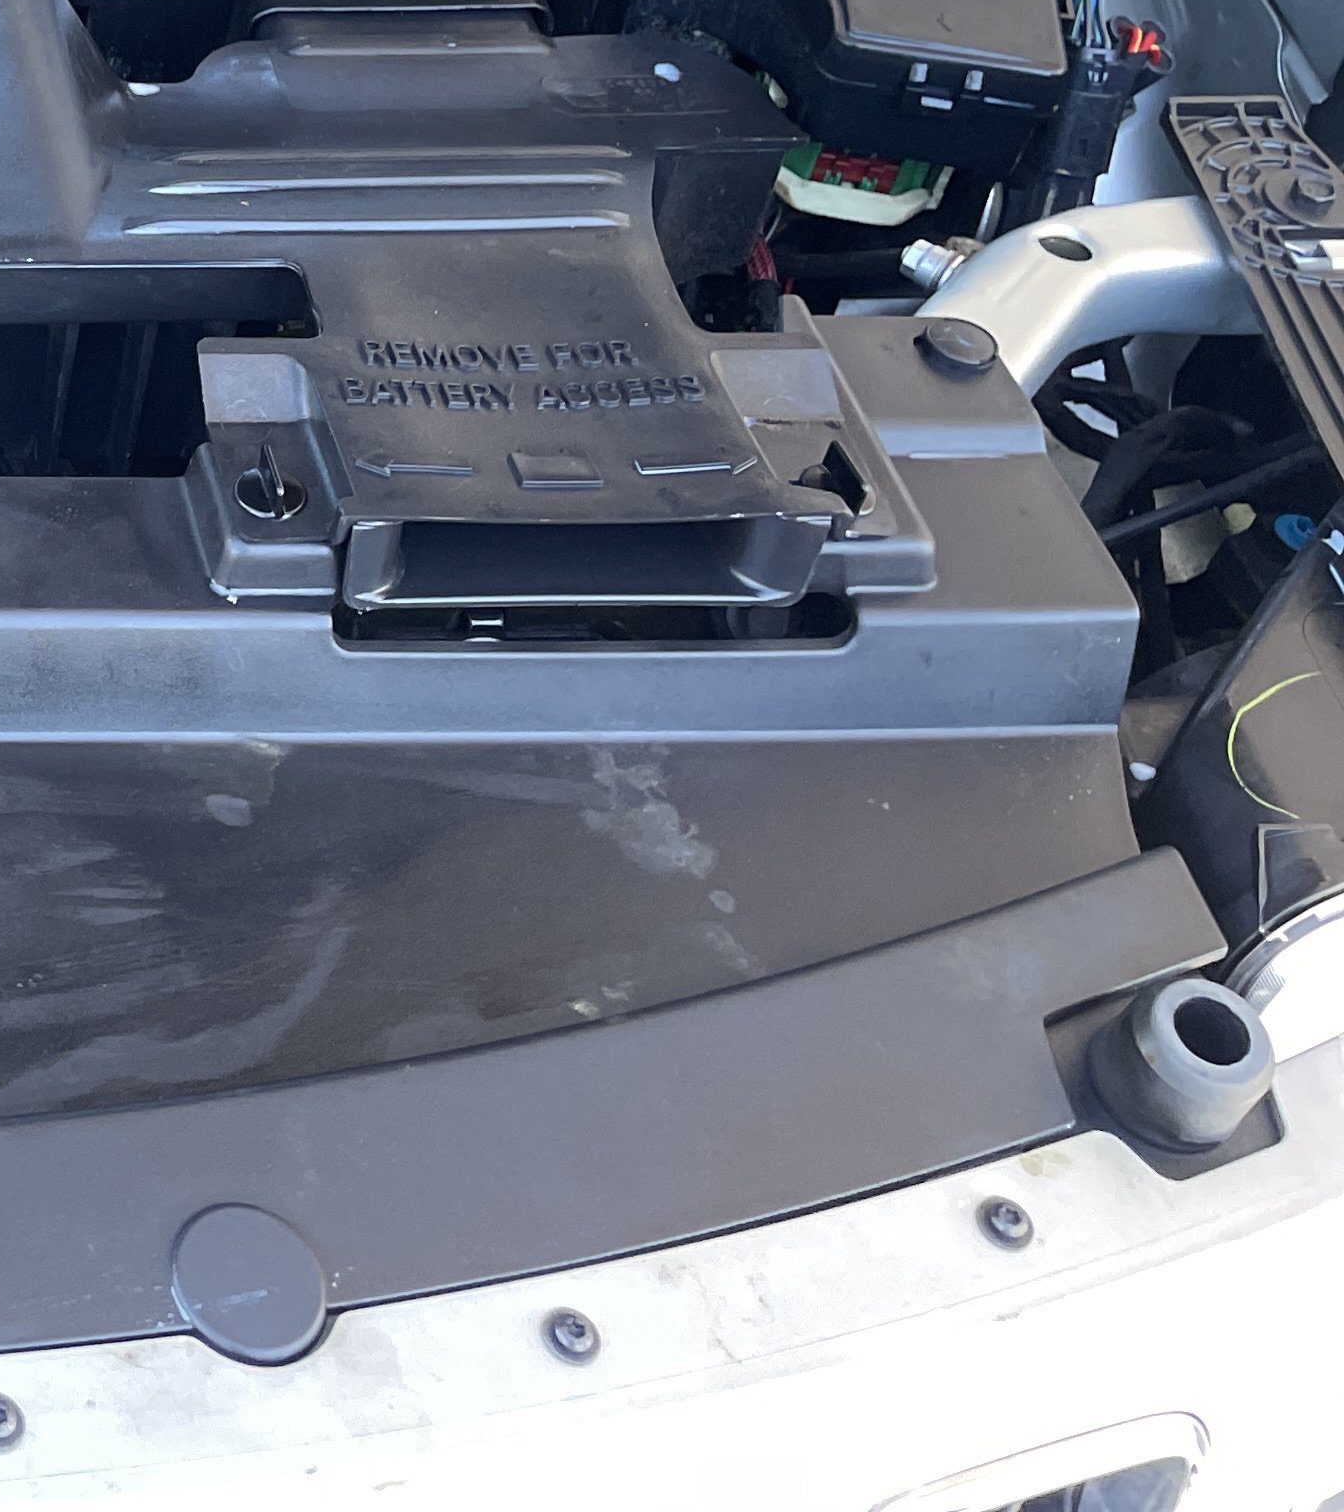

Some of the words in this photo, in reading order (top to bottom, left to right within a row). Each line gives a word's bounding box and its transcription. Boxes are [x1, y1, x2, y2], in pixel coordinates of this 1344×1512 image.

[361, 338, 540, 373] REMOVE
[549, 339, 640, 370] FOR
[341, 376, 516, 411] BATTERY
[537, 374, 706, 410] ACCESS
